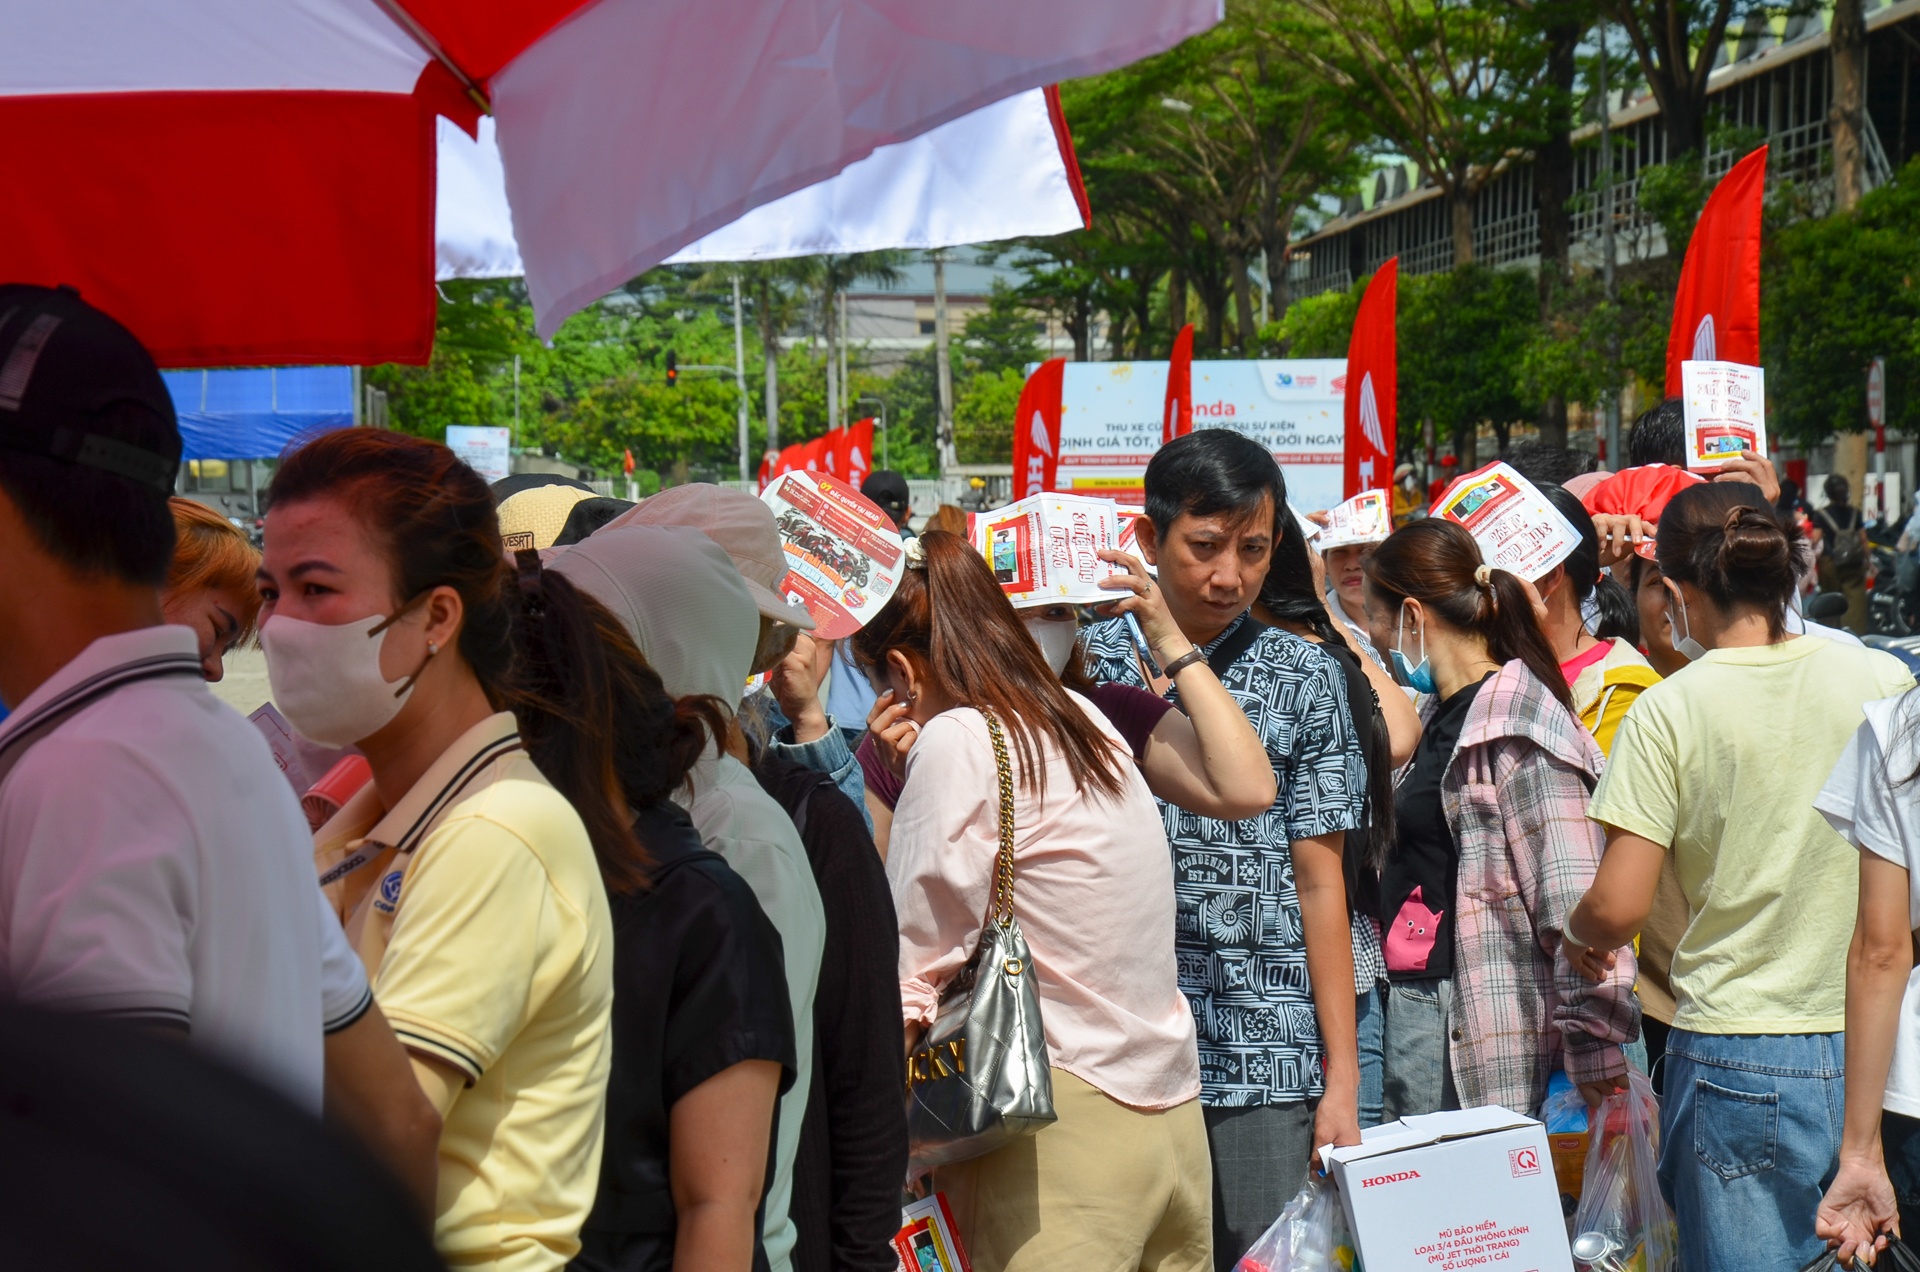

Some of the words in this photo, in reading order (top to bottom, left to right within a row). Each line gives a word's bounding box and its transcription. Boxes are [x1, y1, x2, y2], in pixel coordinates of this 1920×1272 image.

[1191, 400, 1236, 416] nda
[1106, 423, 1127, 431] THU
[1131, 423, 1144, 431] XE
[1253, 420, 1267, 432] SỰ
[1270, 420, 1295, 432] KIỆN
[1096, 436, 1120, 448] GIÁ
[1123, 434, 1153, 448] TỐT,
[1306, 434, 1344, 445] NGAY
[820, 482, 832, 491] 07
[864, 509, 880, 521] HEAD
[1073, 513, 1087, 522] 3
[1050, 526, 1068, 568] 0.55%
[1072, 523, 1092, 551] triệu
[1079, 551, 1098, 583] đồng
[1177, 854, 1231, 876] ICONDENIM
[1188, 869, 1217, 883] EST.19
[1362, 1170, 1421, 1188] HONDA
[1439, 1229, 1452, 1239] MŨ
[1454, 1225, 1474, 1237] BẢO
[1475, 1220, 1497, 1232] HIỂM
[1414, 1244, 1435, 1256] LOẠI
[1437, 1241, 1452, 1252] 3/4
[1454, 1236, 1473, 1247] ĐẦU
[1475, 1230, 1507, 1243] KHÔNG
[1508, 1226, 1529, 1237] KÍNH
[1427, 1252, 1445, 1264] (MŨ
[1446, 1250, 1461, 1260] JET
[1463, 1245, 1485, 1256] THỜI
[1486, 1239, 1520, 1252] TRANG)
[1442, 1259, 1454, 1271] SỐ
[1456, 1255, 1487, 1268] LƯỢNG
[1488, 1254, 1493, 1262] 1
[1494, 1251, 1510, 1260] CÁI
